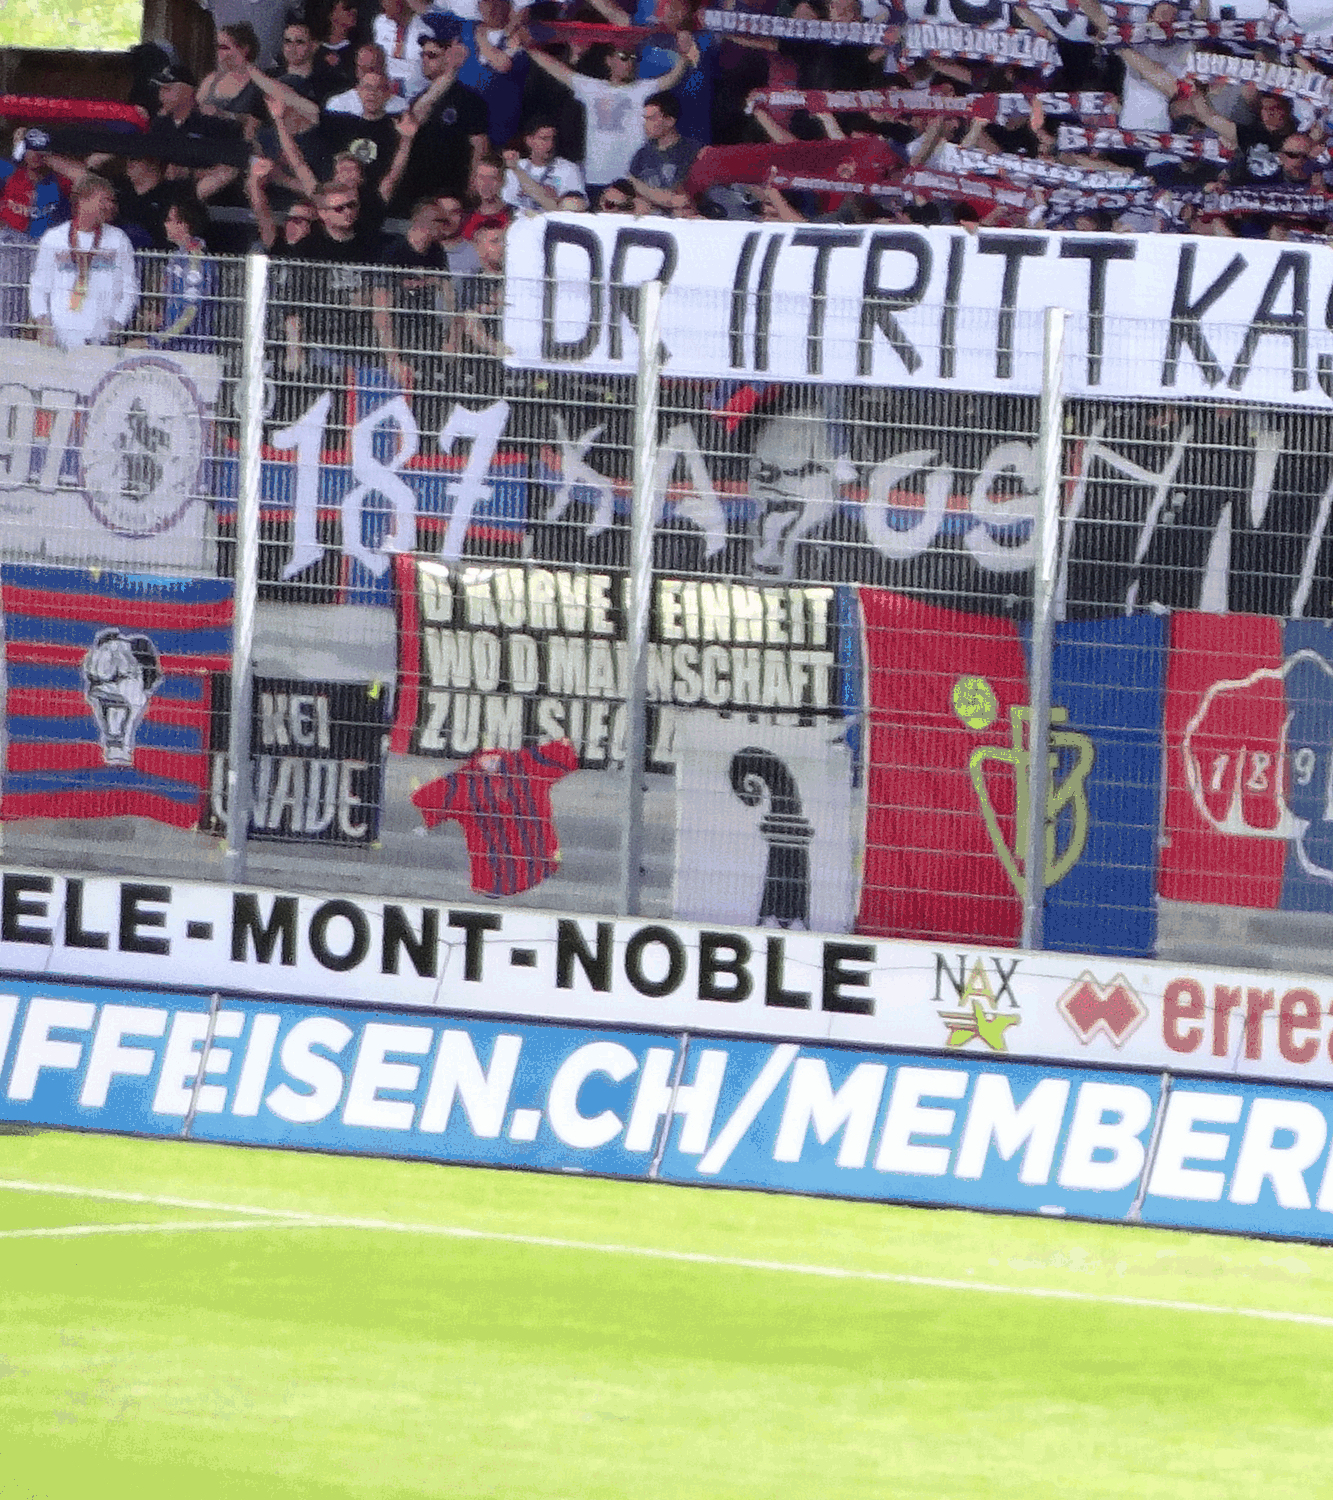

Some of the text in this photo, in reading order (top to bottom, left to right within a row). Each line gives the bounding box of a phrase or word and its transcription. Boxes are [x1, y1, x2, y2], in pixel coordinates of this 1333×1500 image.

[541, 220, 680, 361] DR
[424, 626, 500, 692] WO
[507, 630, 540, 694] D
[260, 693, 331, 750] KEI
[420, 689, 524, 752] ZUM
[930, 954, 1024, 1011] NAX
